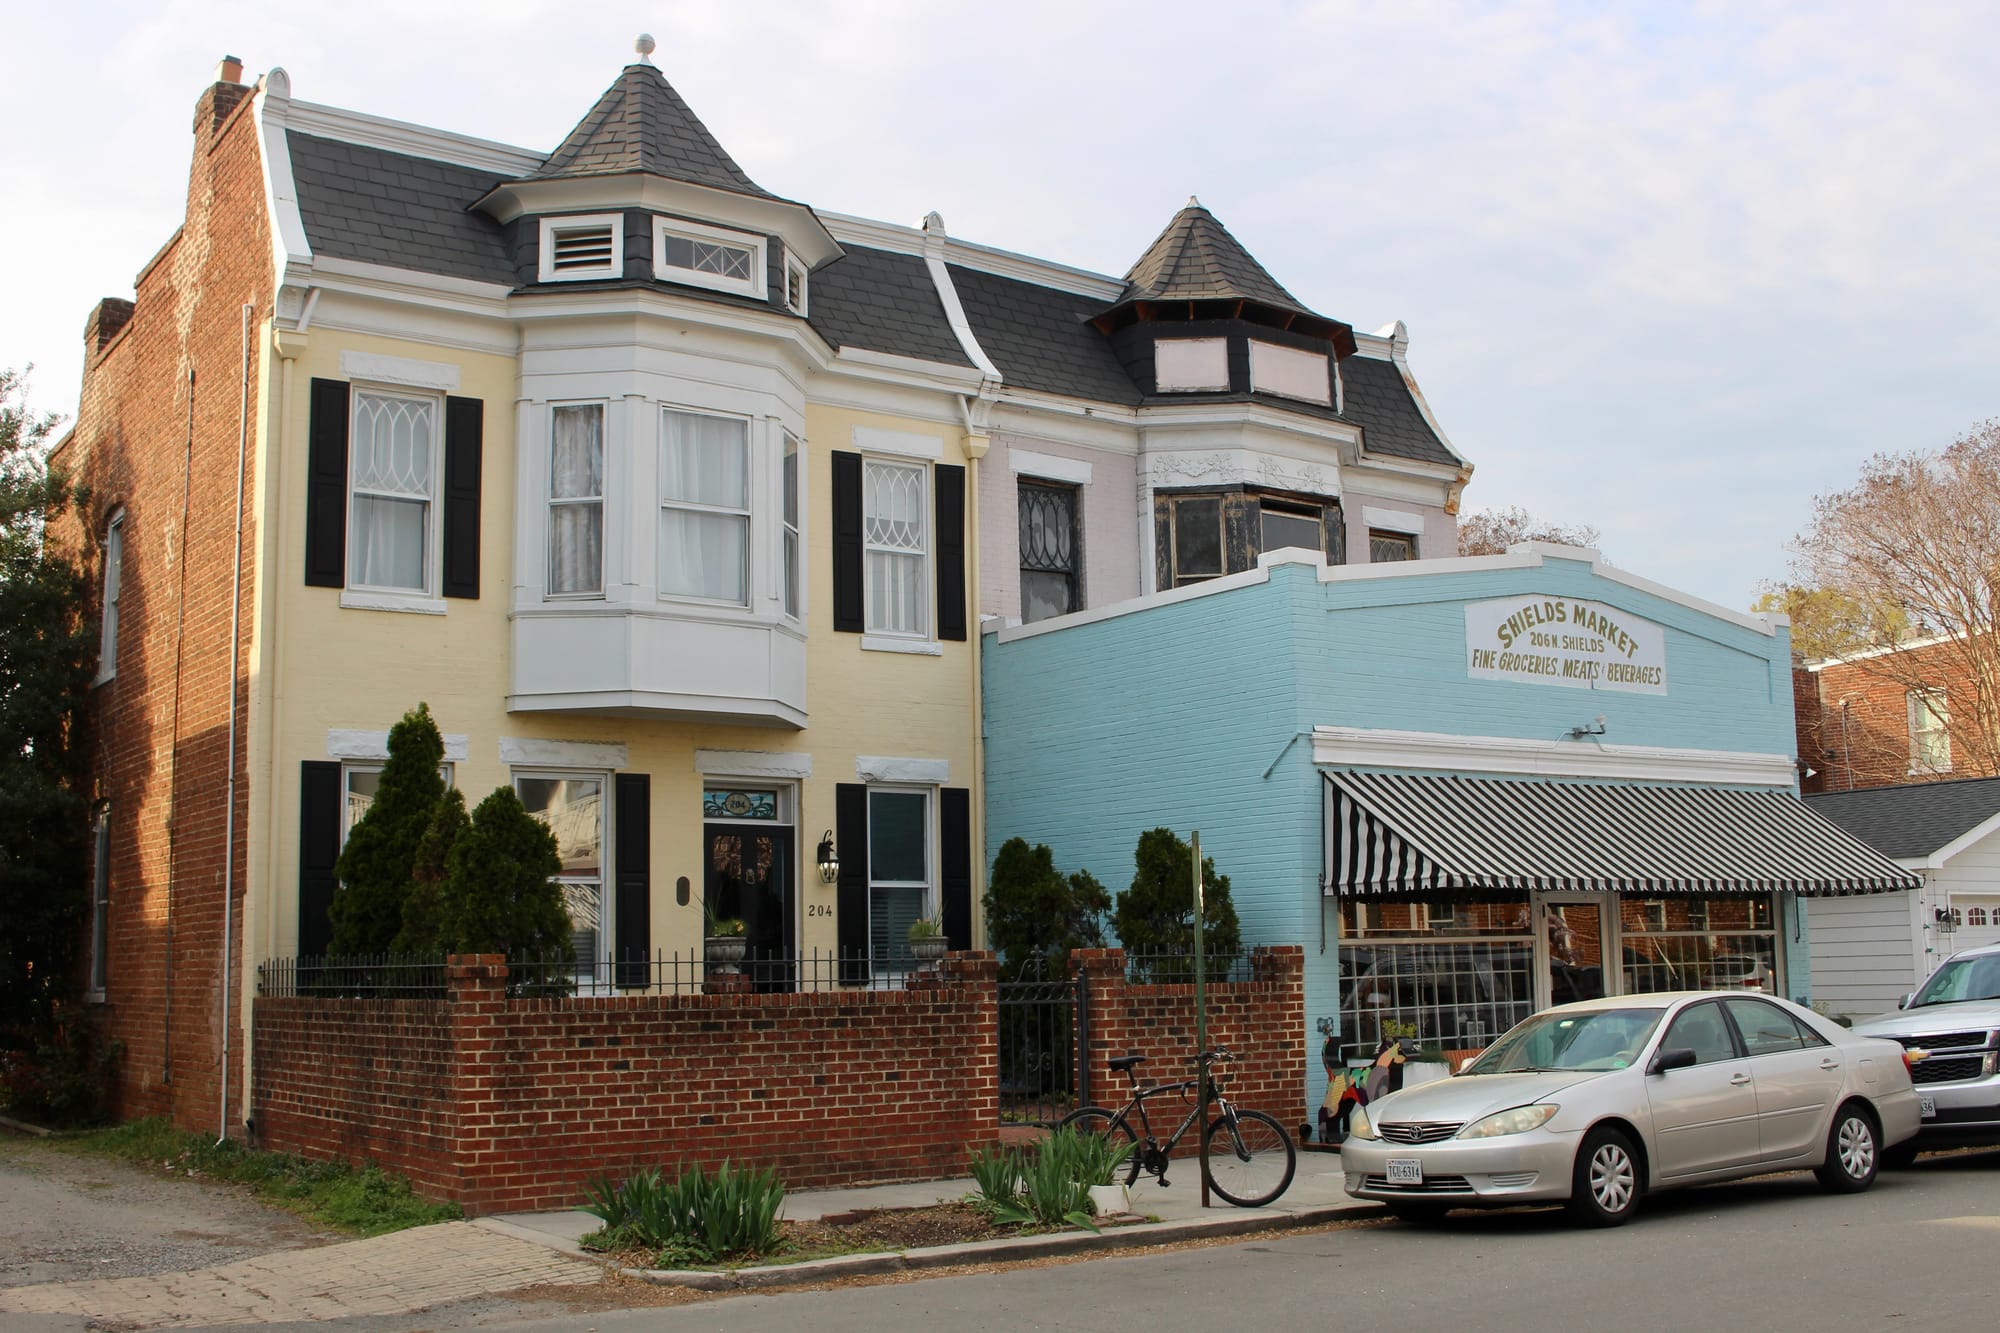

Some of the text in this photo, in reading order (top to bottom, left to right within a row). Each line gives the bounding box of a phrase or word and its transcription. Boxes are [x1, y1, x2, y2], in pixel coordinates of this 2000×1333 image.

[1497, 602, 1638, 659] SHIELDS MARKET
[1530, 632, 1550, 648] 206
[1562, 635, 1605, 653] SHIELDS
[1472, 649, 1497, 669] FINE
[1563, 658, 1600, 680] MEATS
[1607, 662, 1661, 685] BEVERAGES
[731, 800, 746, 809] 204
[808, 904, 832, 917] 204
